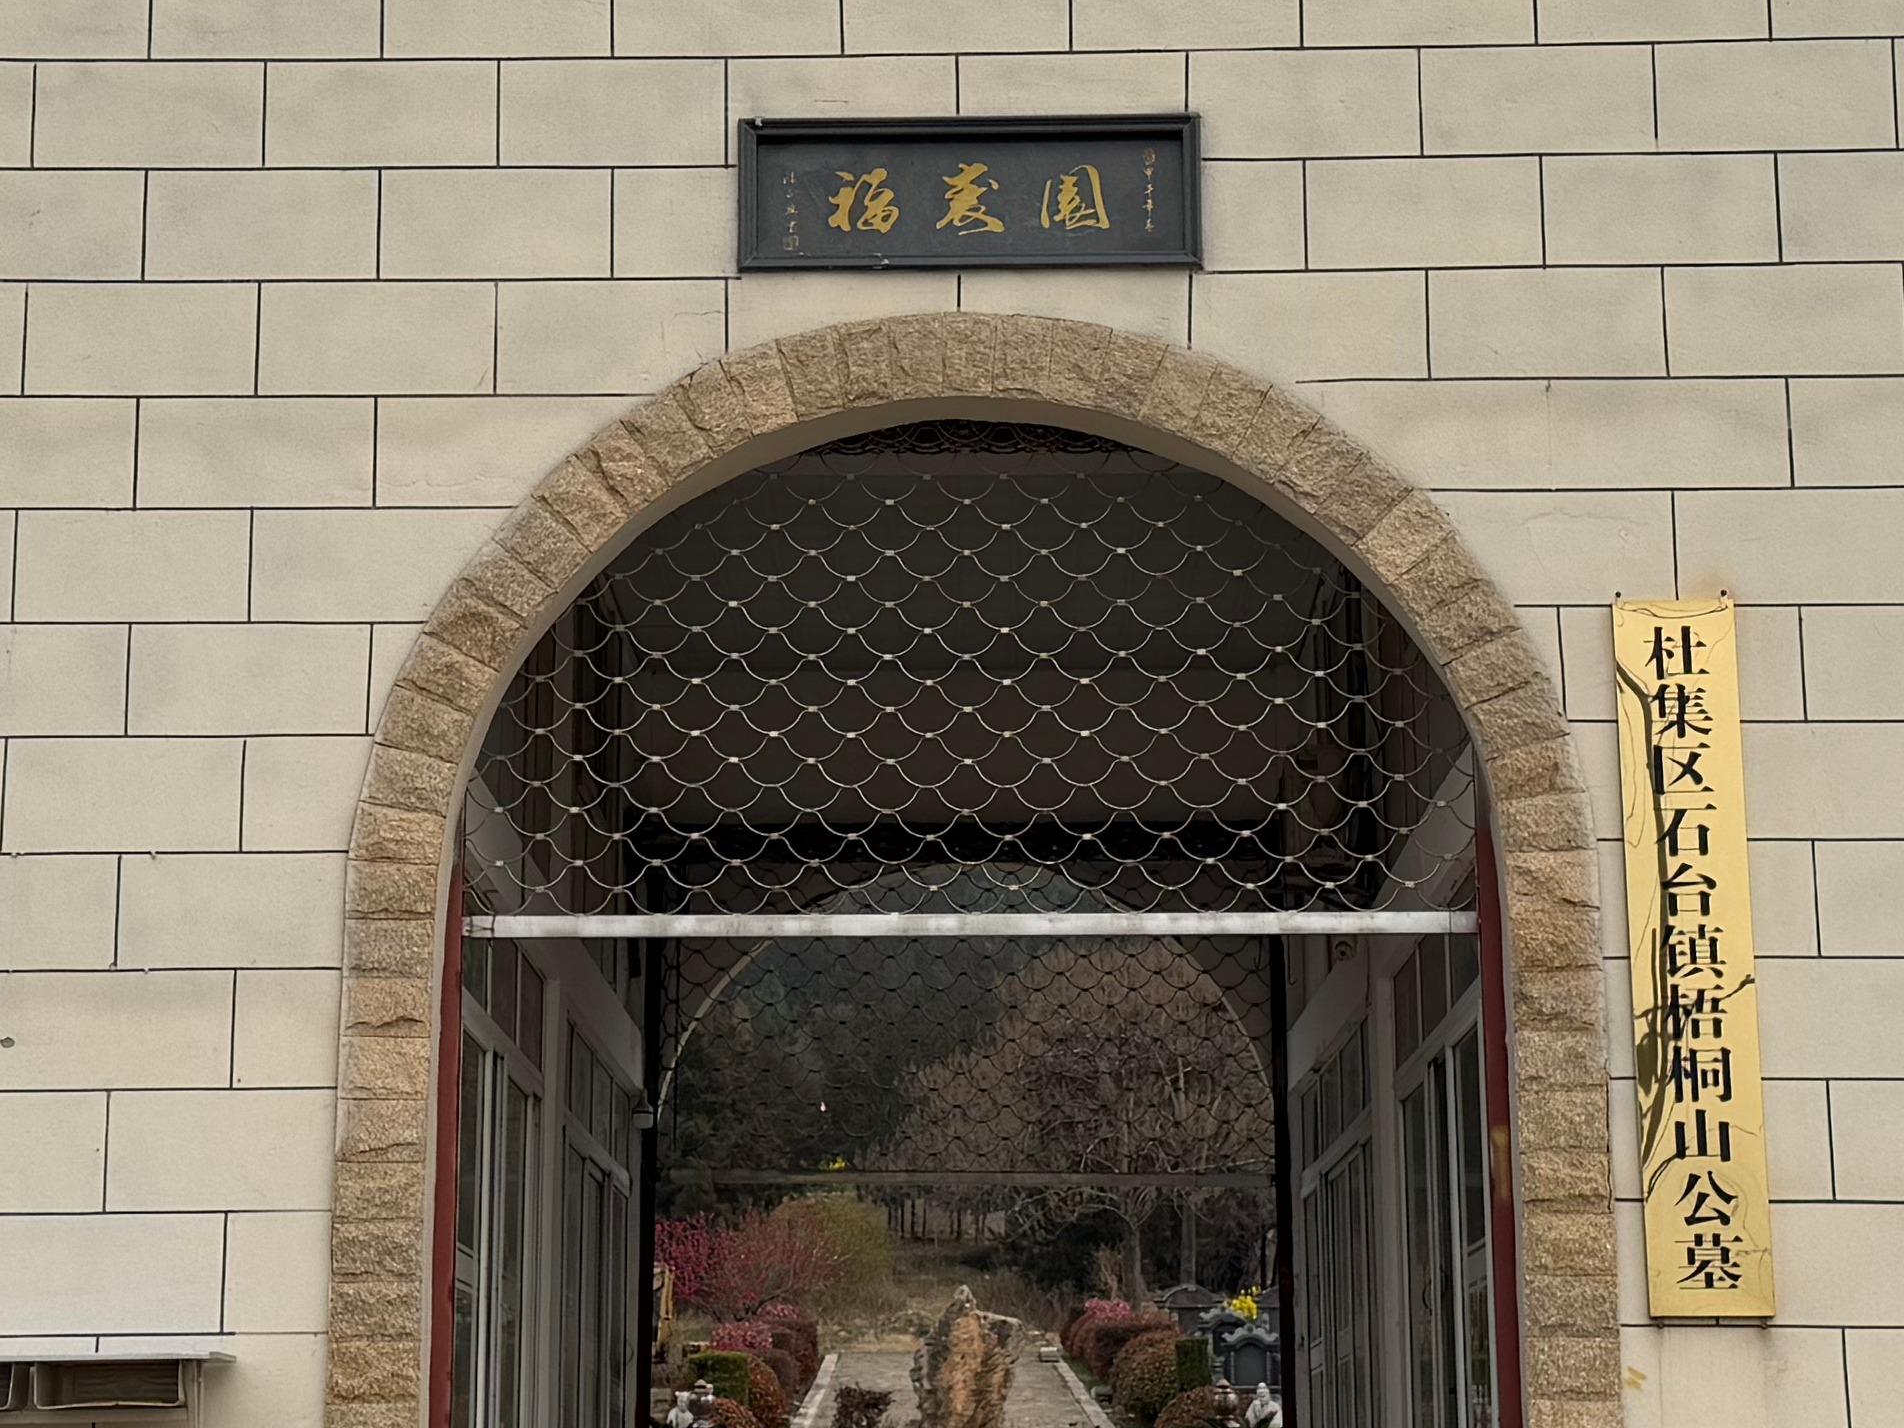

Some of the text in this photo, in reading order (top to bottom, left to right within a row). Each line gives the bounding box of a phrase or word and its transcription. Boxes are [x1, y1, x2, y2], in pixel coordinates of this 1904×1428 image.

[1643, 625, 1743, 1290] 杜集区石台镇梧桐山公墓
